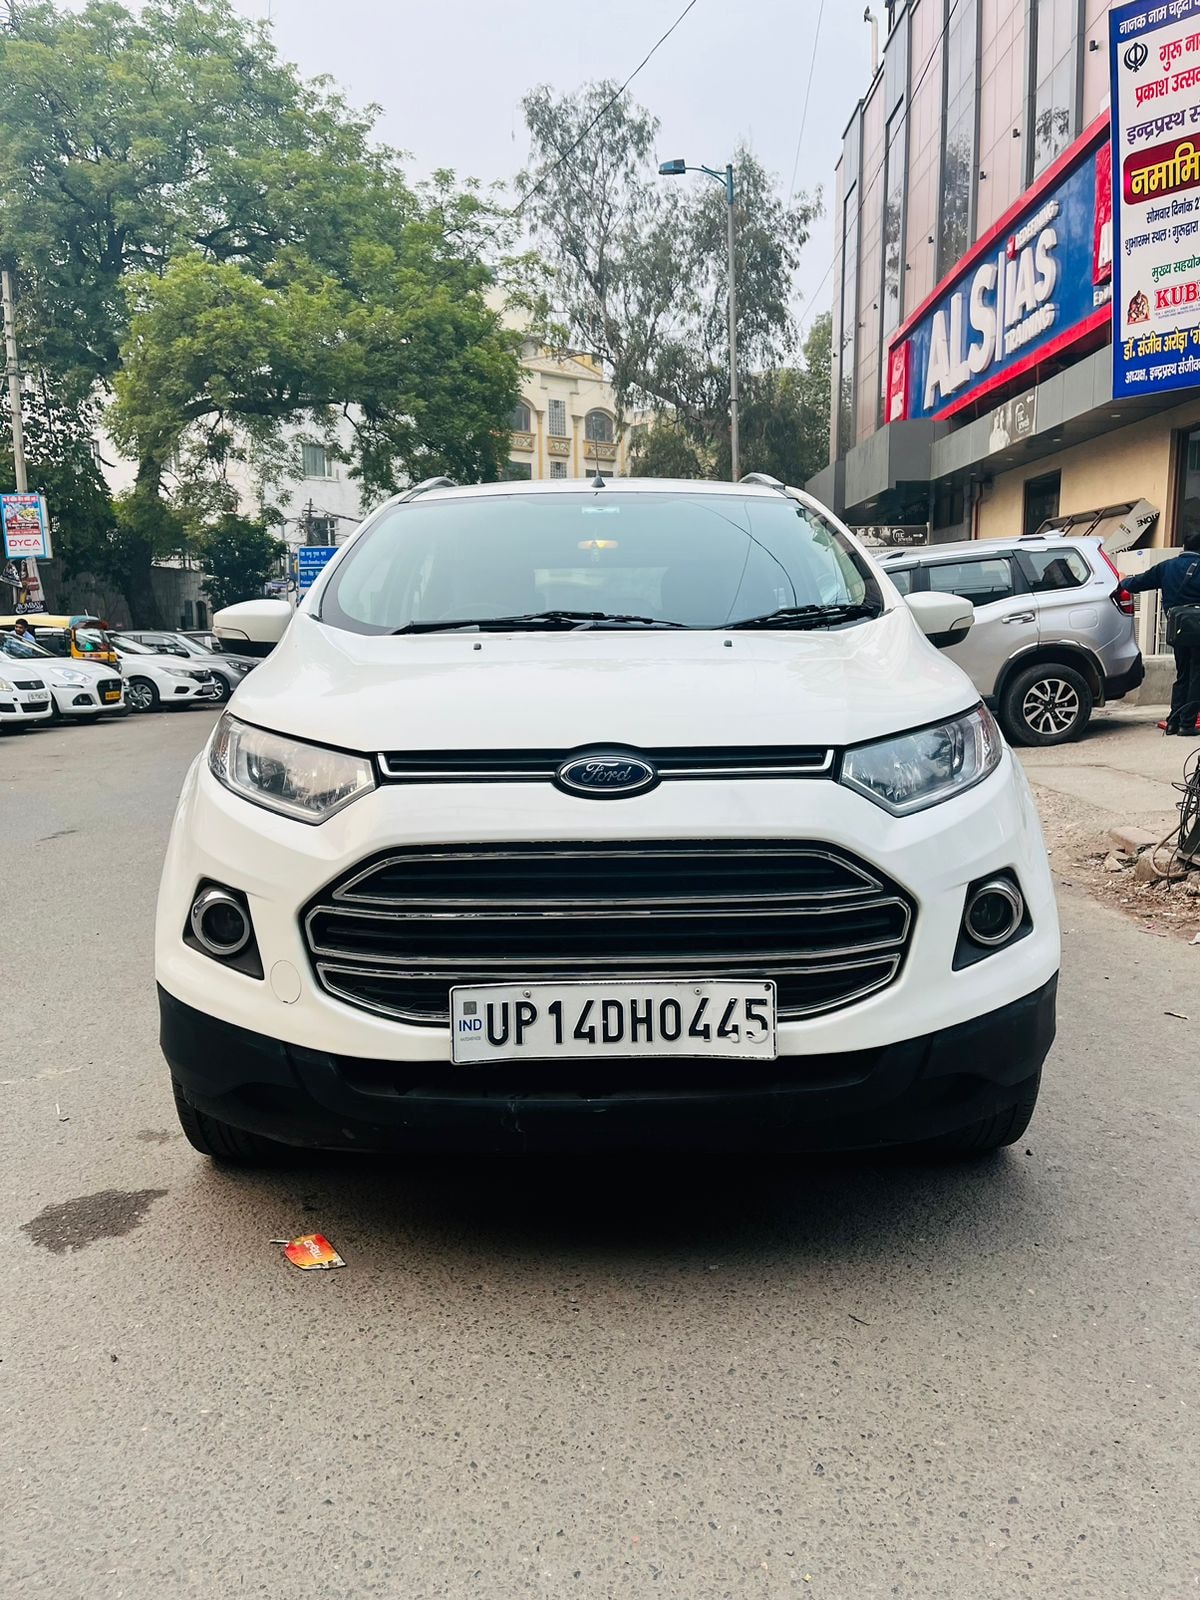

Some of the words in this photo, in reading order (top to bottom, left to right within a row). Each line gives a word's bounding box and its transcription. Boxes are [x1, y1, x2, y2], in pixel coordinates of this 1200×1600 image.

[1119, 13, 1146, 35] नानक
[1148, 5, 1167, 24] नाम
[1185, 32, 1200, 52] ना
[1135, 77, 1169, 108] प्रकाश
[1126, 109, 1186, 145] इन्द्रप्रस्थ
[1131, 141, 1200, 196] नमामि
[1146, 207, 1171, 223] सोमवार
[1172, 198, 1193, 217] दिनांक
[1125, 233, 1150, 256] शुभारम्भ
[1151, 228, 1167, 244] स्थल
[1152, 263, 1171, 283] मुख्य
[1154, 281, 1200, 309] KUB
[923, 263, 997, 410] ALS
[1123, 337, 1136, 360] डॉ.
[1137, 331, 1162, 357] संजीव
[1163, 327, 1188, 353] अरोड़ा
[1149, 363, 1177, 381] इन्द्रप्रस्थ
[1178, 355, 1200, 375] संजीव
[9, 539, 41, 547] DYCA
[581, 762, 632, 783] Ford
[458, 1018, 482, 1032] IND
[486, 997, 768, 1045] UP14DH0445
